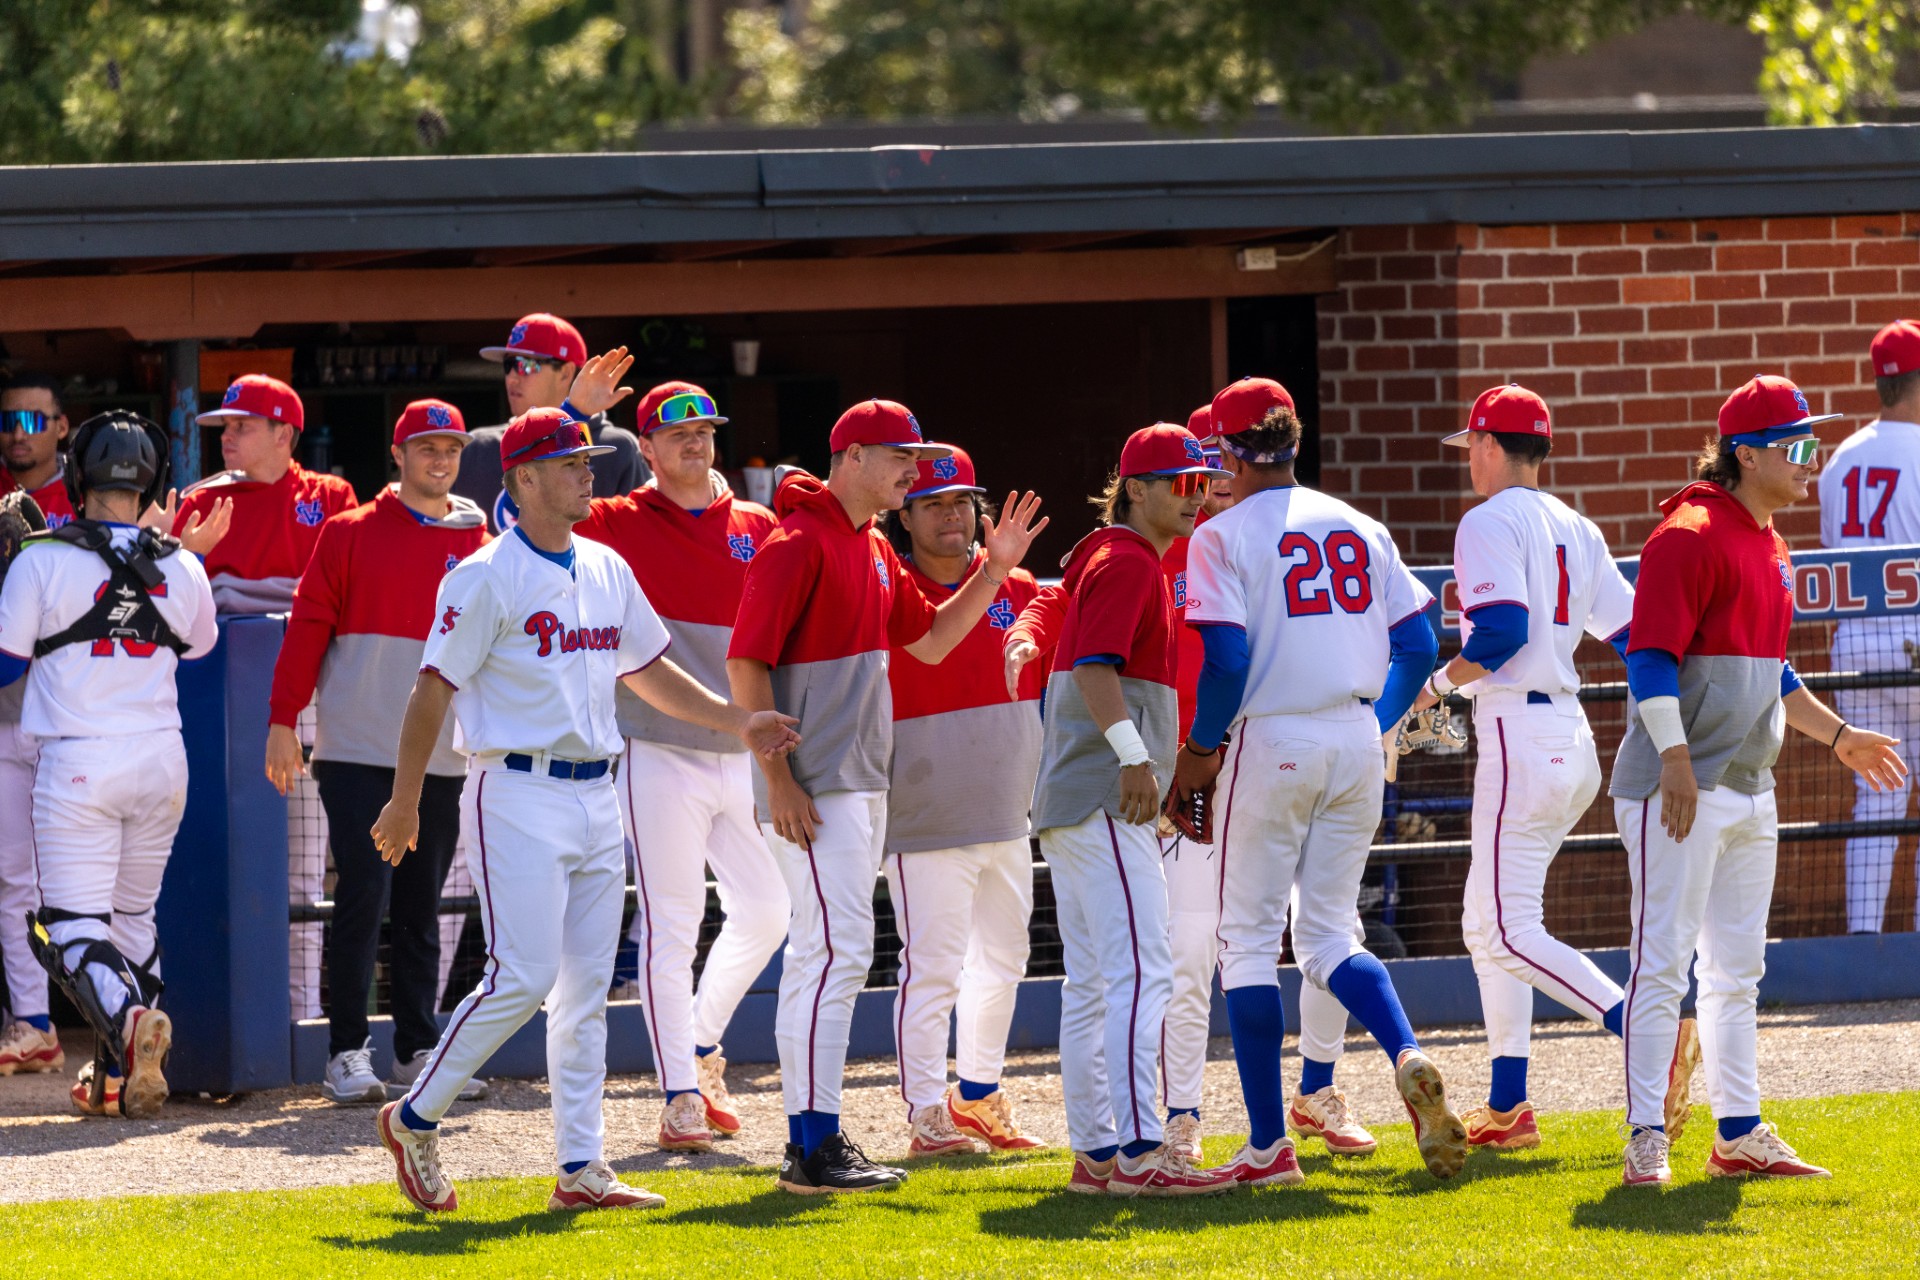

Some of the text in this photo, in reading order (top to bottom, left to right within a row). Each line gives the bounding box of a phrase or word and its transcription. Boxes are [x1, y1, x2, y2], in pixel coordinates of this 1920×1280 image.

[1841, 466, 1900, 538] 17
[1278, 530, 1374, 618] 28
[1553, 544, 1571, 626] 1
[1792, 557, 1920, 614] OL S
